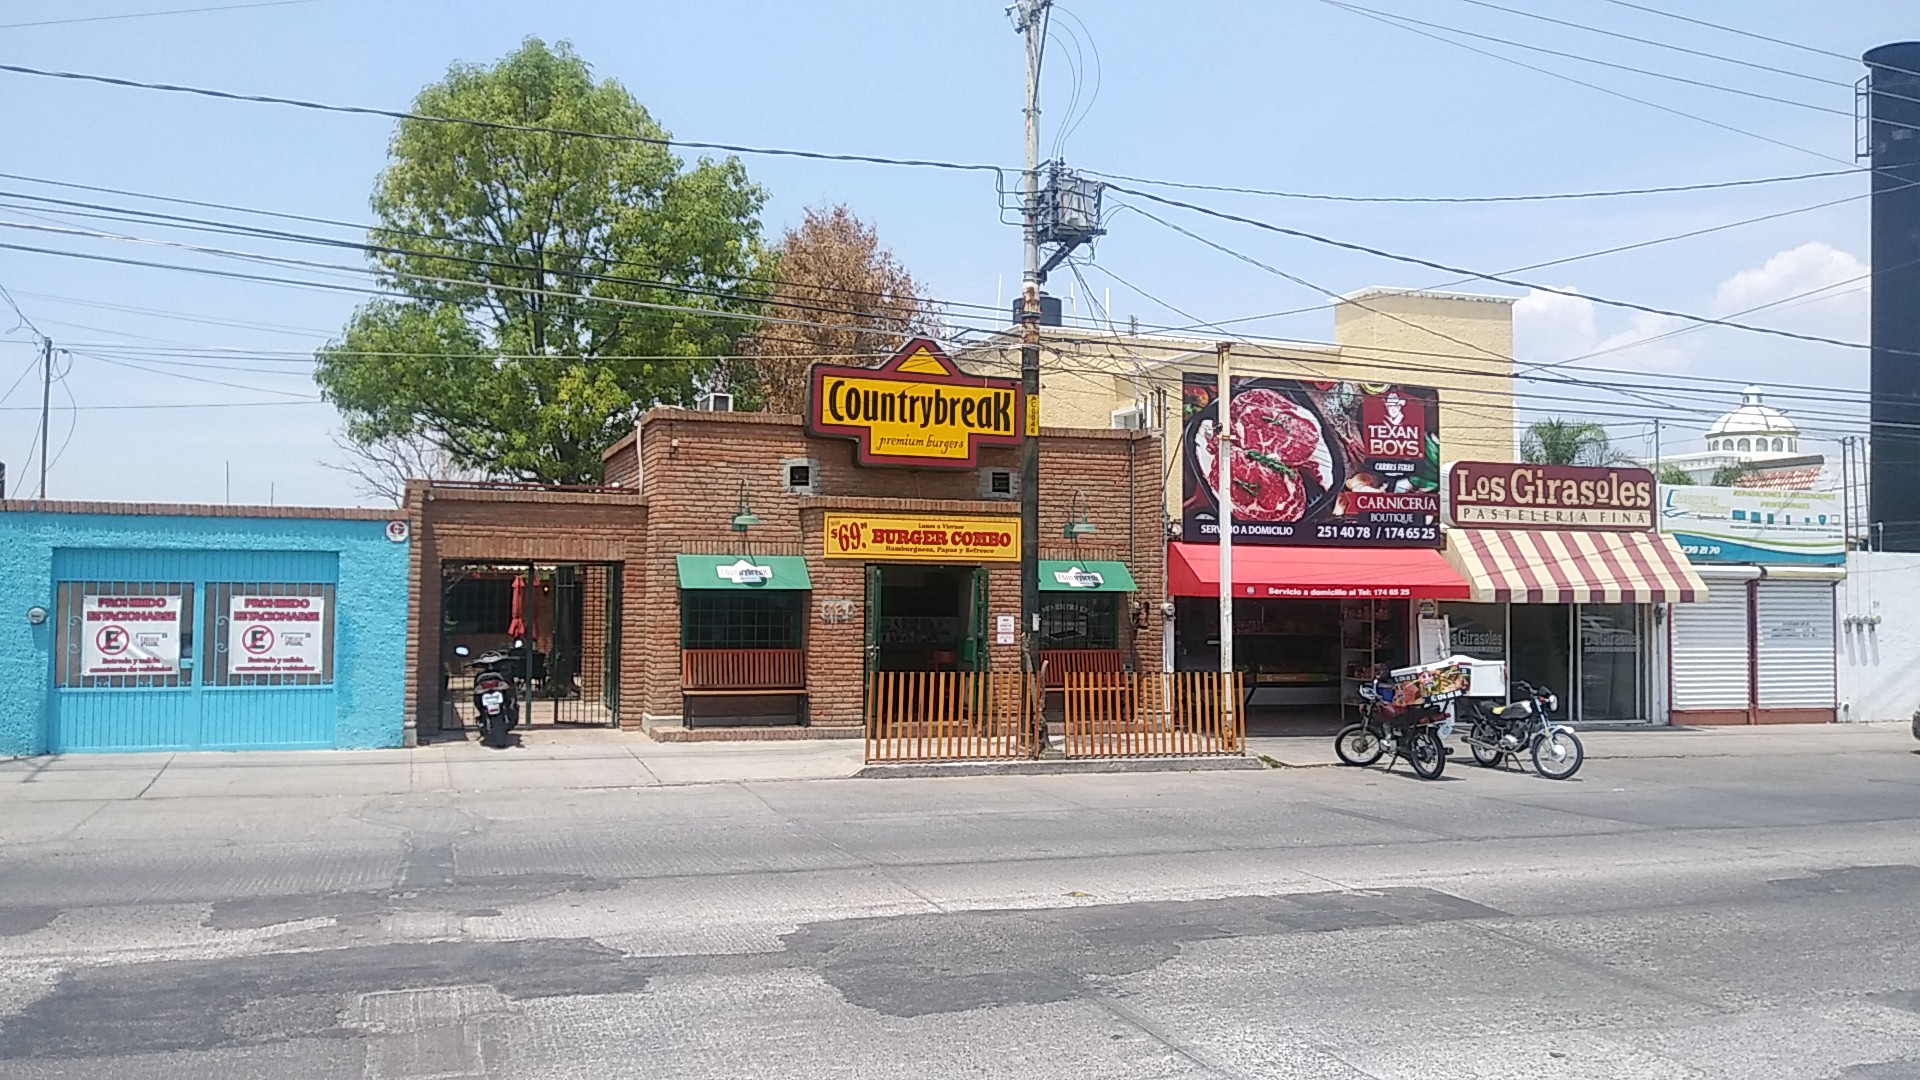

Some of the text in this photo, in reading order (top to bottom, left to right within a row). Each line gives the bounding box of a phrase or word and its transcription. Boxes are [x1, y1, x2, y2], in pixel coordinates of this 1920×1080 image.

[1368, 425, 1419, 440] TEXAN
[875, 434, 964, 454] premium burgers
[1370, 439, 1419, 456] BOYS
[1456, 469, 1650, 507] Los Girasoles
[1357, 495, 1437, 511] CARNICERÍA
[1370, 513, 1413, 524] BOUTIQUE
[1600, 512, 1645, 525] FINA
[871, 528, 1011, 547] BURGER COMBO
[1241, 526, 1247, 535] A
[1248, 525, 1294, 536] DOMICILIO
[1317, 525, 1435, 540] 251 40 78 / 174 65 25
[1268, 587, 1302, 596] Servicio
[1310, 588, 1348, 596] domicilio
[1348, 588, 1357, 596] al
[1358, 588, 1372, 596] Tel:
[1389, 589, 1399, 597] 65
